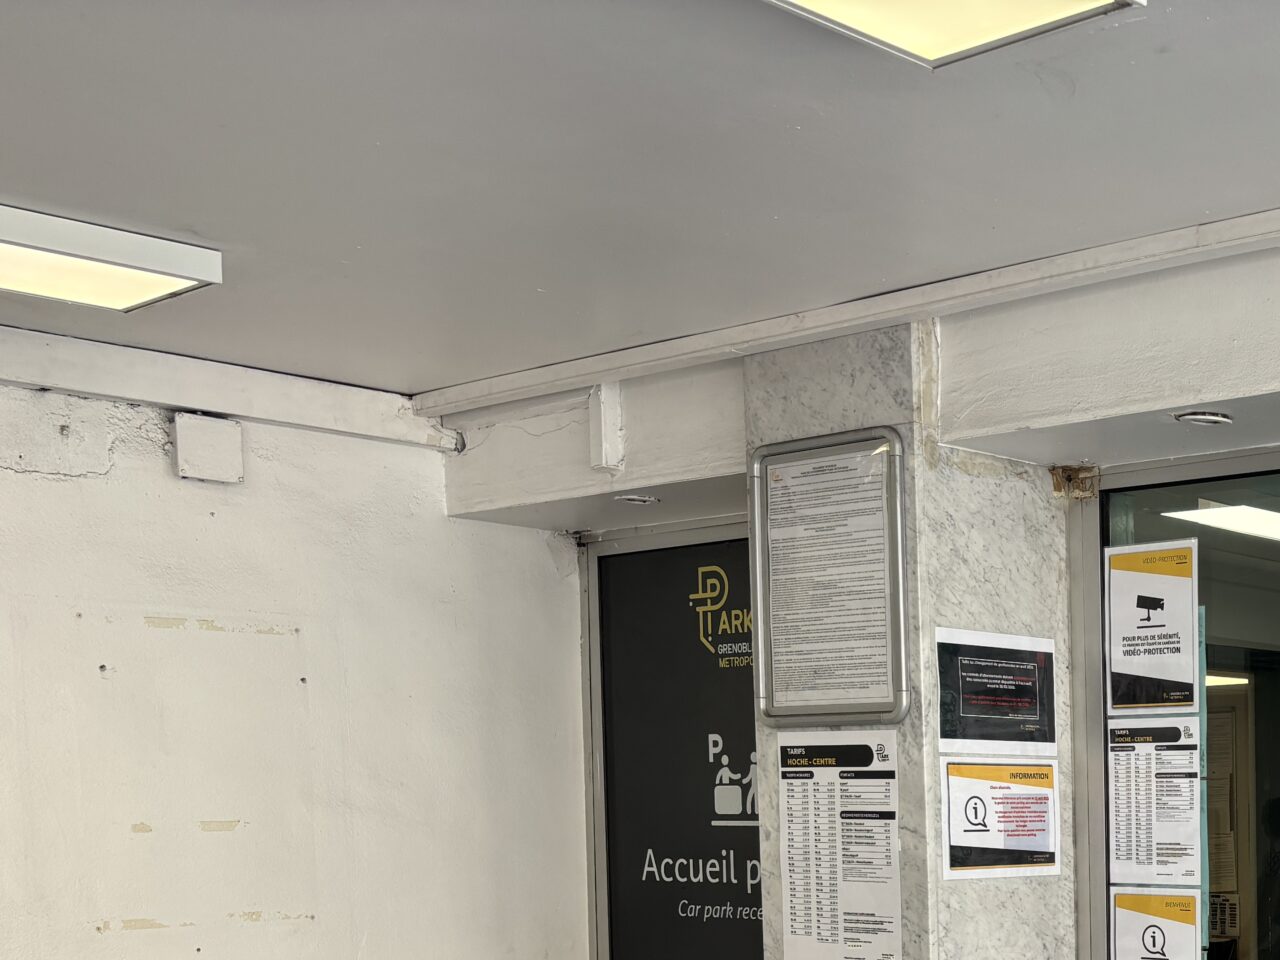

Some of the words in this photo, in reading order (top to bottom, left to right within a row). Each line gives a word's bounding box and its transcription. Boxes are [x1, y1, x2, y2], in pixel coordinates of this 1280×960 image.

[718, 642, 752, 654] GRENOBL
[1122, 646, 1181, 656] VIDÉO-PROTECTION
[719, 656, 754, 668] METROPO
[642, 848, 738, 883] Accueil
[678, 899, 701, 917] Car
[704, 902, 733, 922] park
[737, 906, 763, 920] rece
